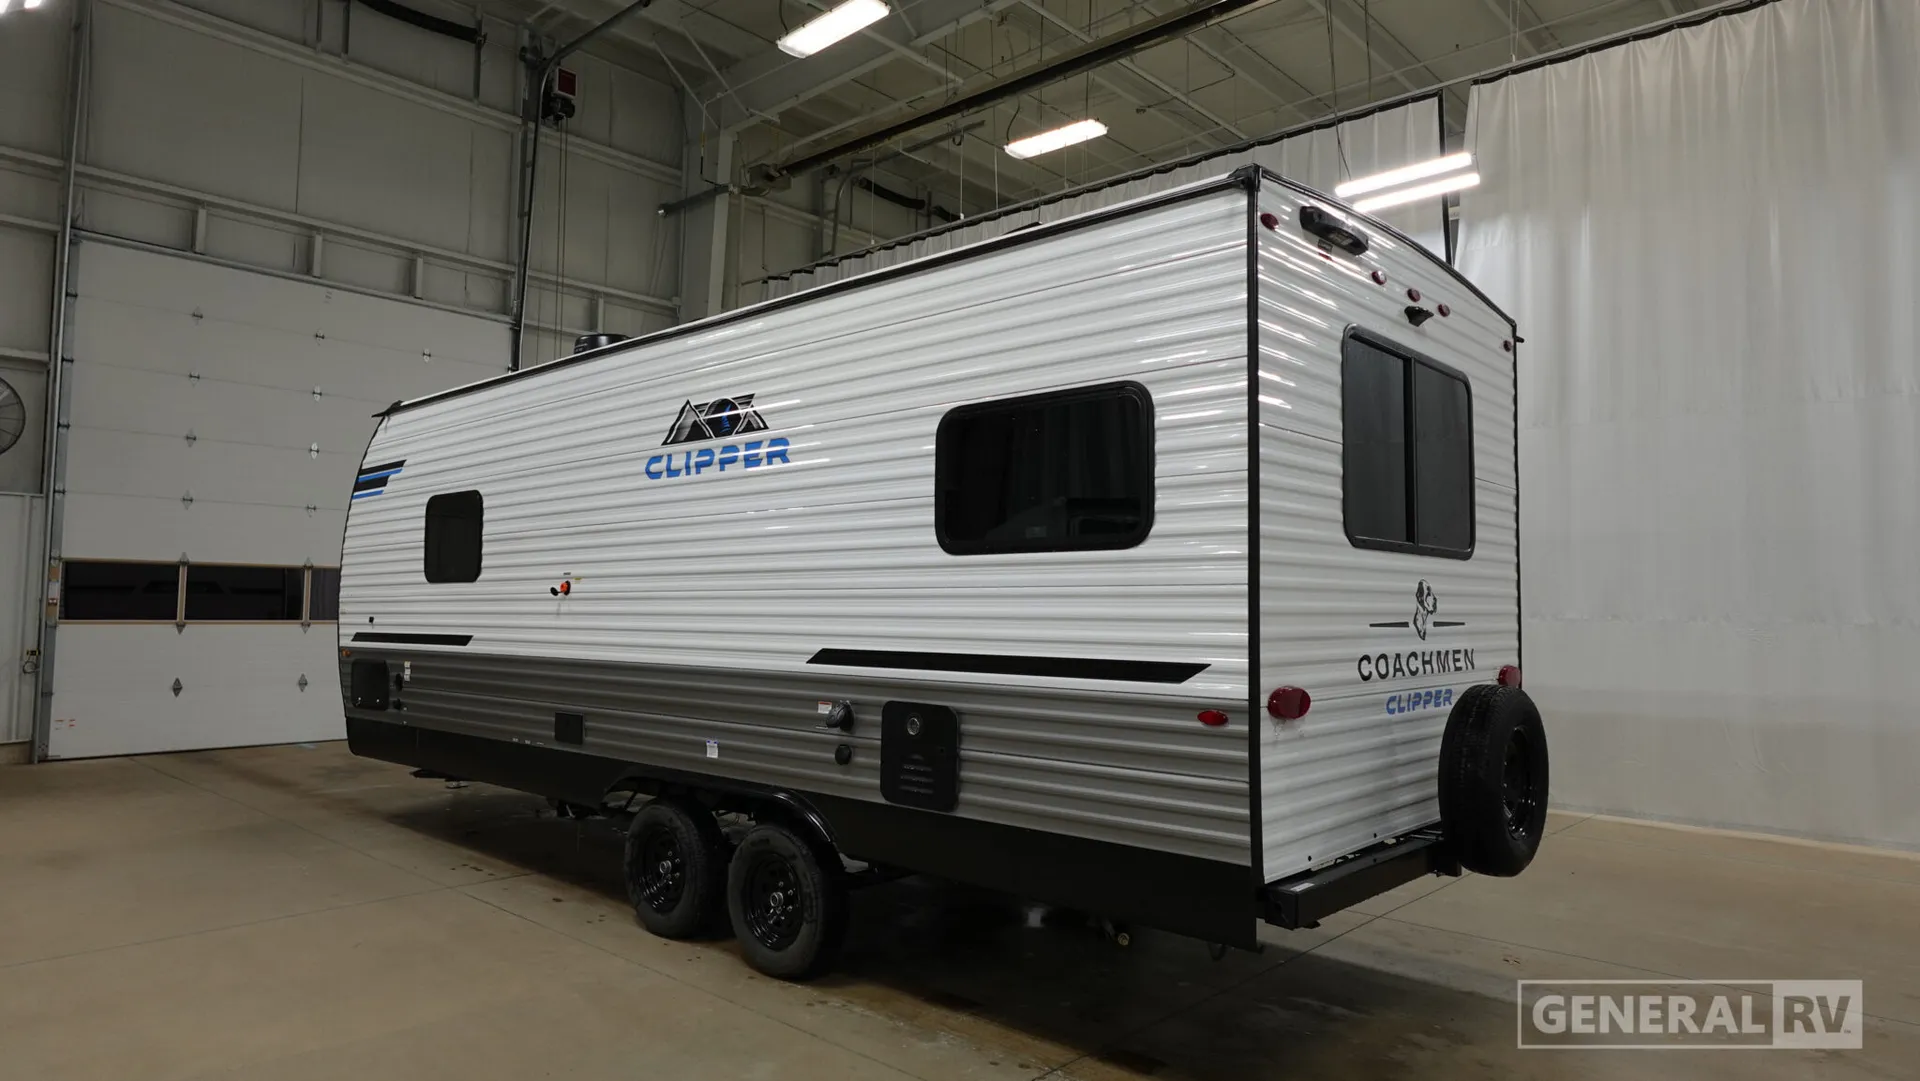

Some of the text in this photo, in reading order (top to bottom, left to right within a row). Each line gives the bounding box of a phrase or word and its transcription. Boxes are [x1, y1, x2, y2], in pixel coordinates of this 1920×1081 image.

[645, 437, 790, 479] CLIPPER
[1358, 649, 1475, 681] COACHMEN
[1386, 689, 1453, 714] CLIPPER
